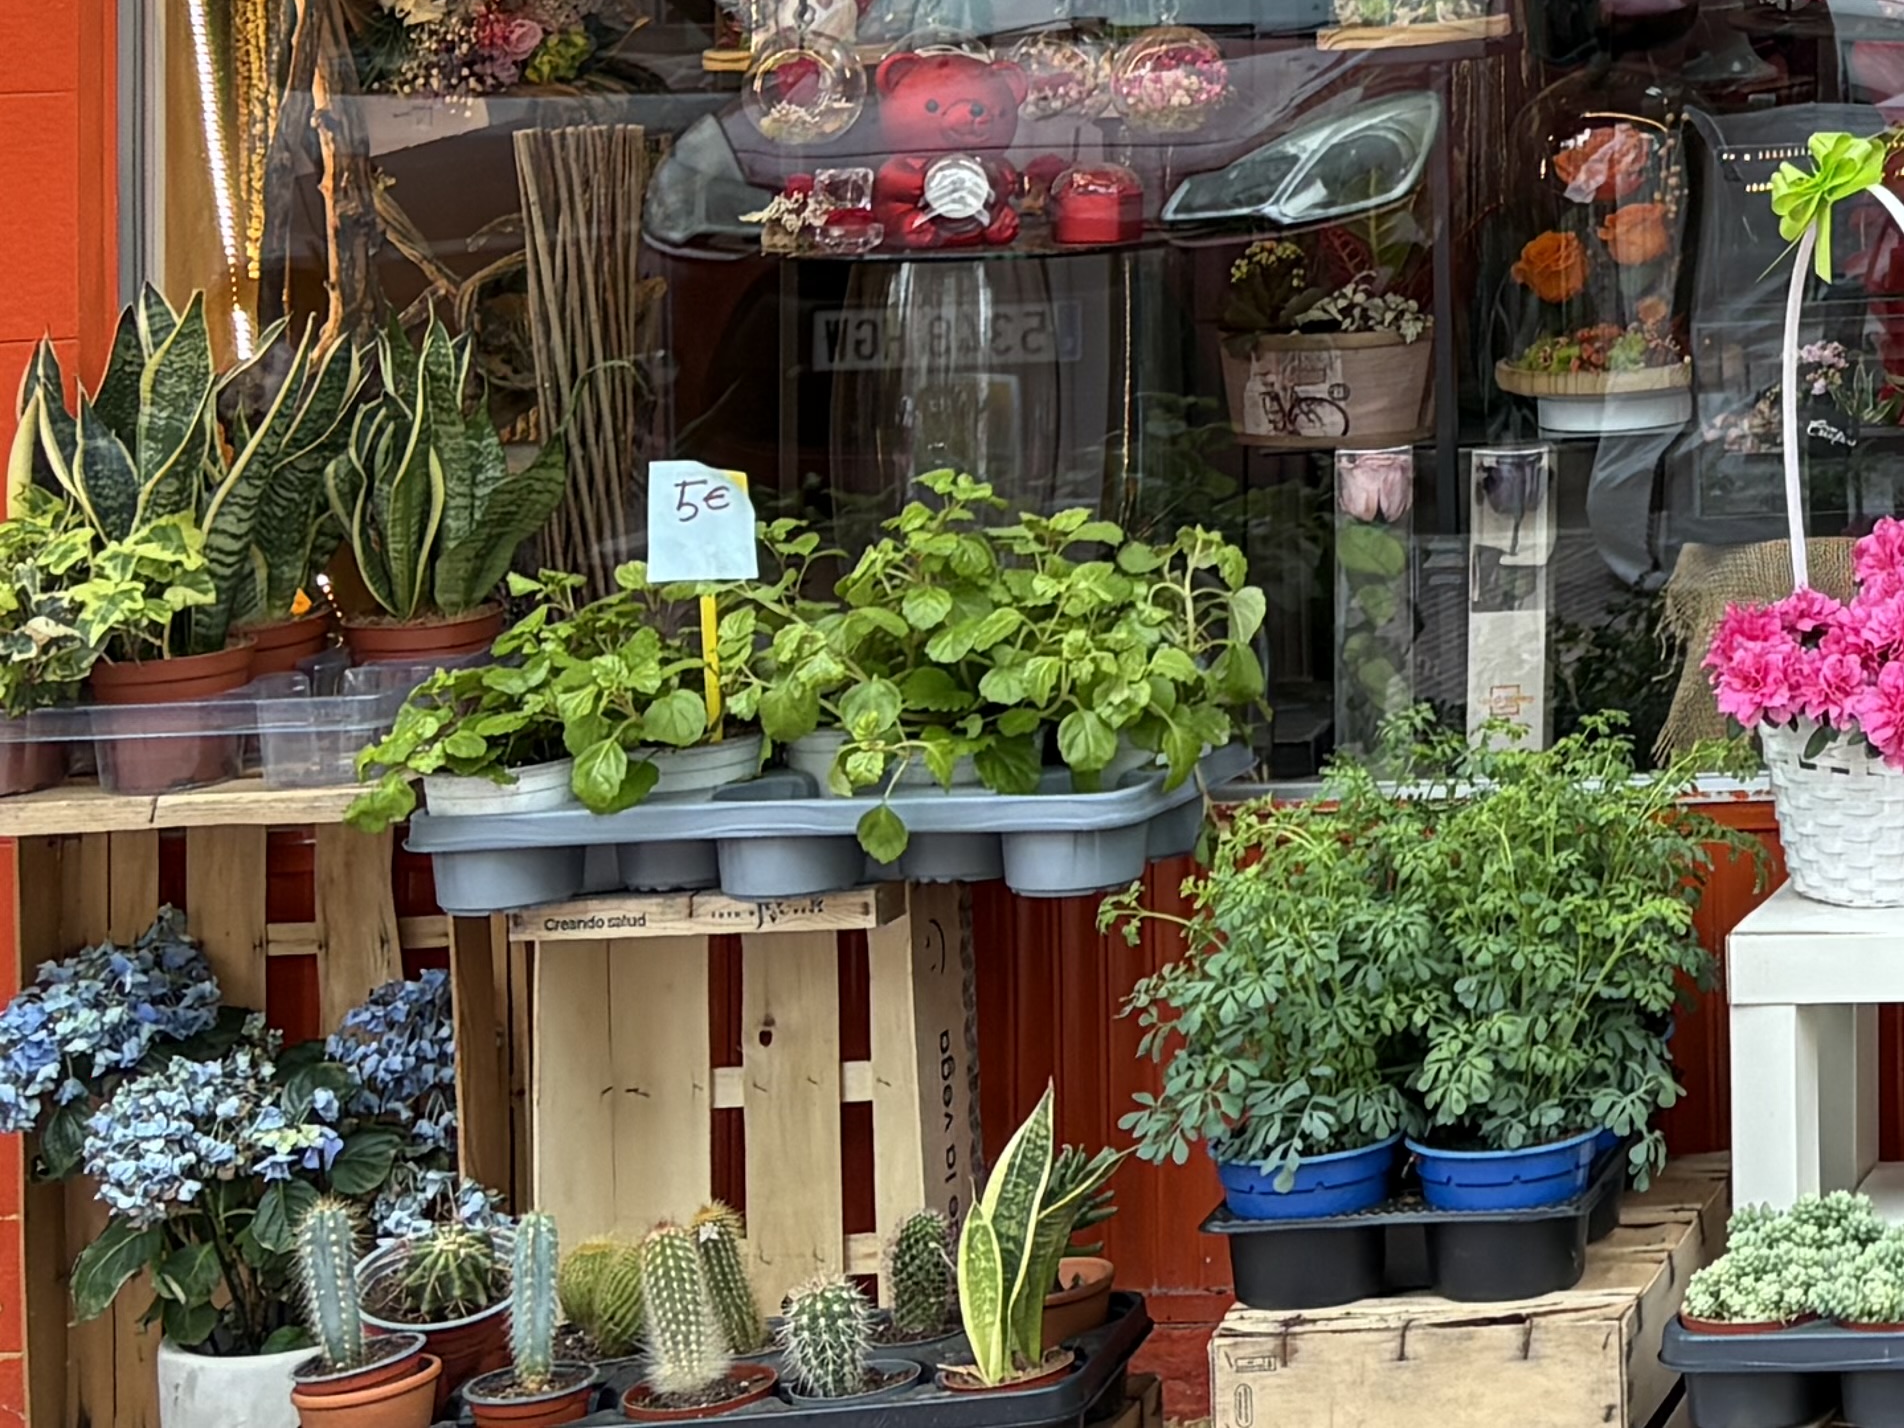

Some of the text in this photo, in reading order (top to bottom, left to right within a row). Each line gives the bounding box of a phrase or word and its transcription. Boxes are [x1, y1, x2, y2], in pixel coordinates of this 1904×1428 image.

[672, 478, 732, 523] 5€
[543, 914, 606, 933] Creando
[939, 1029, 957, 1134] vega
